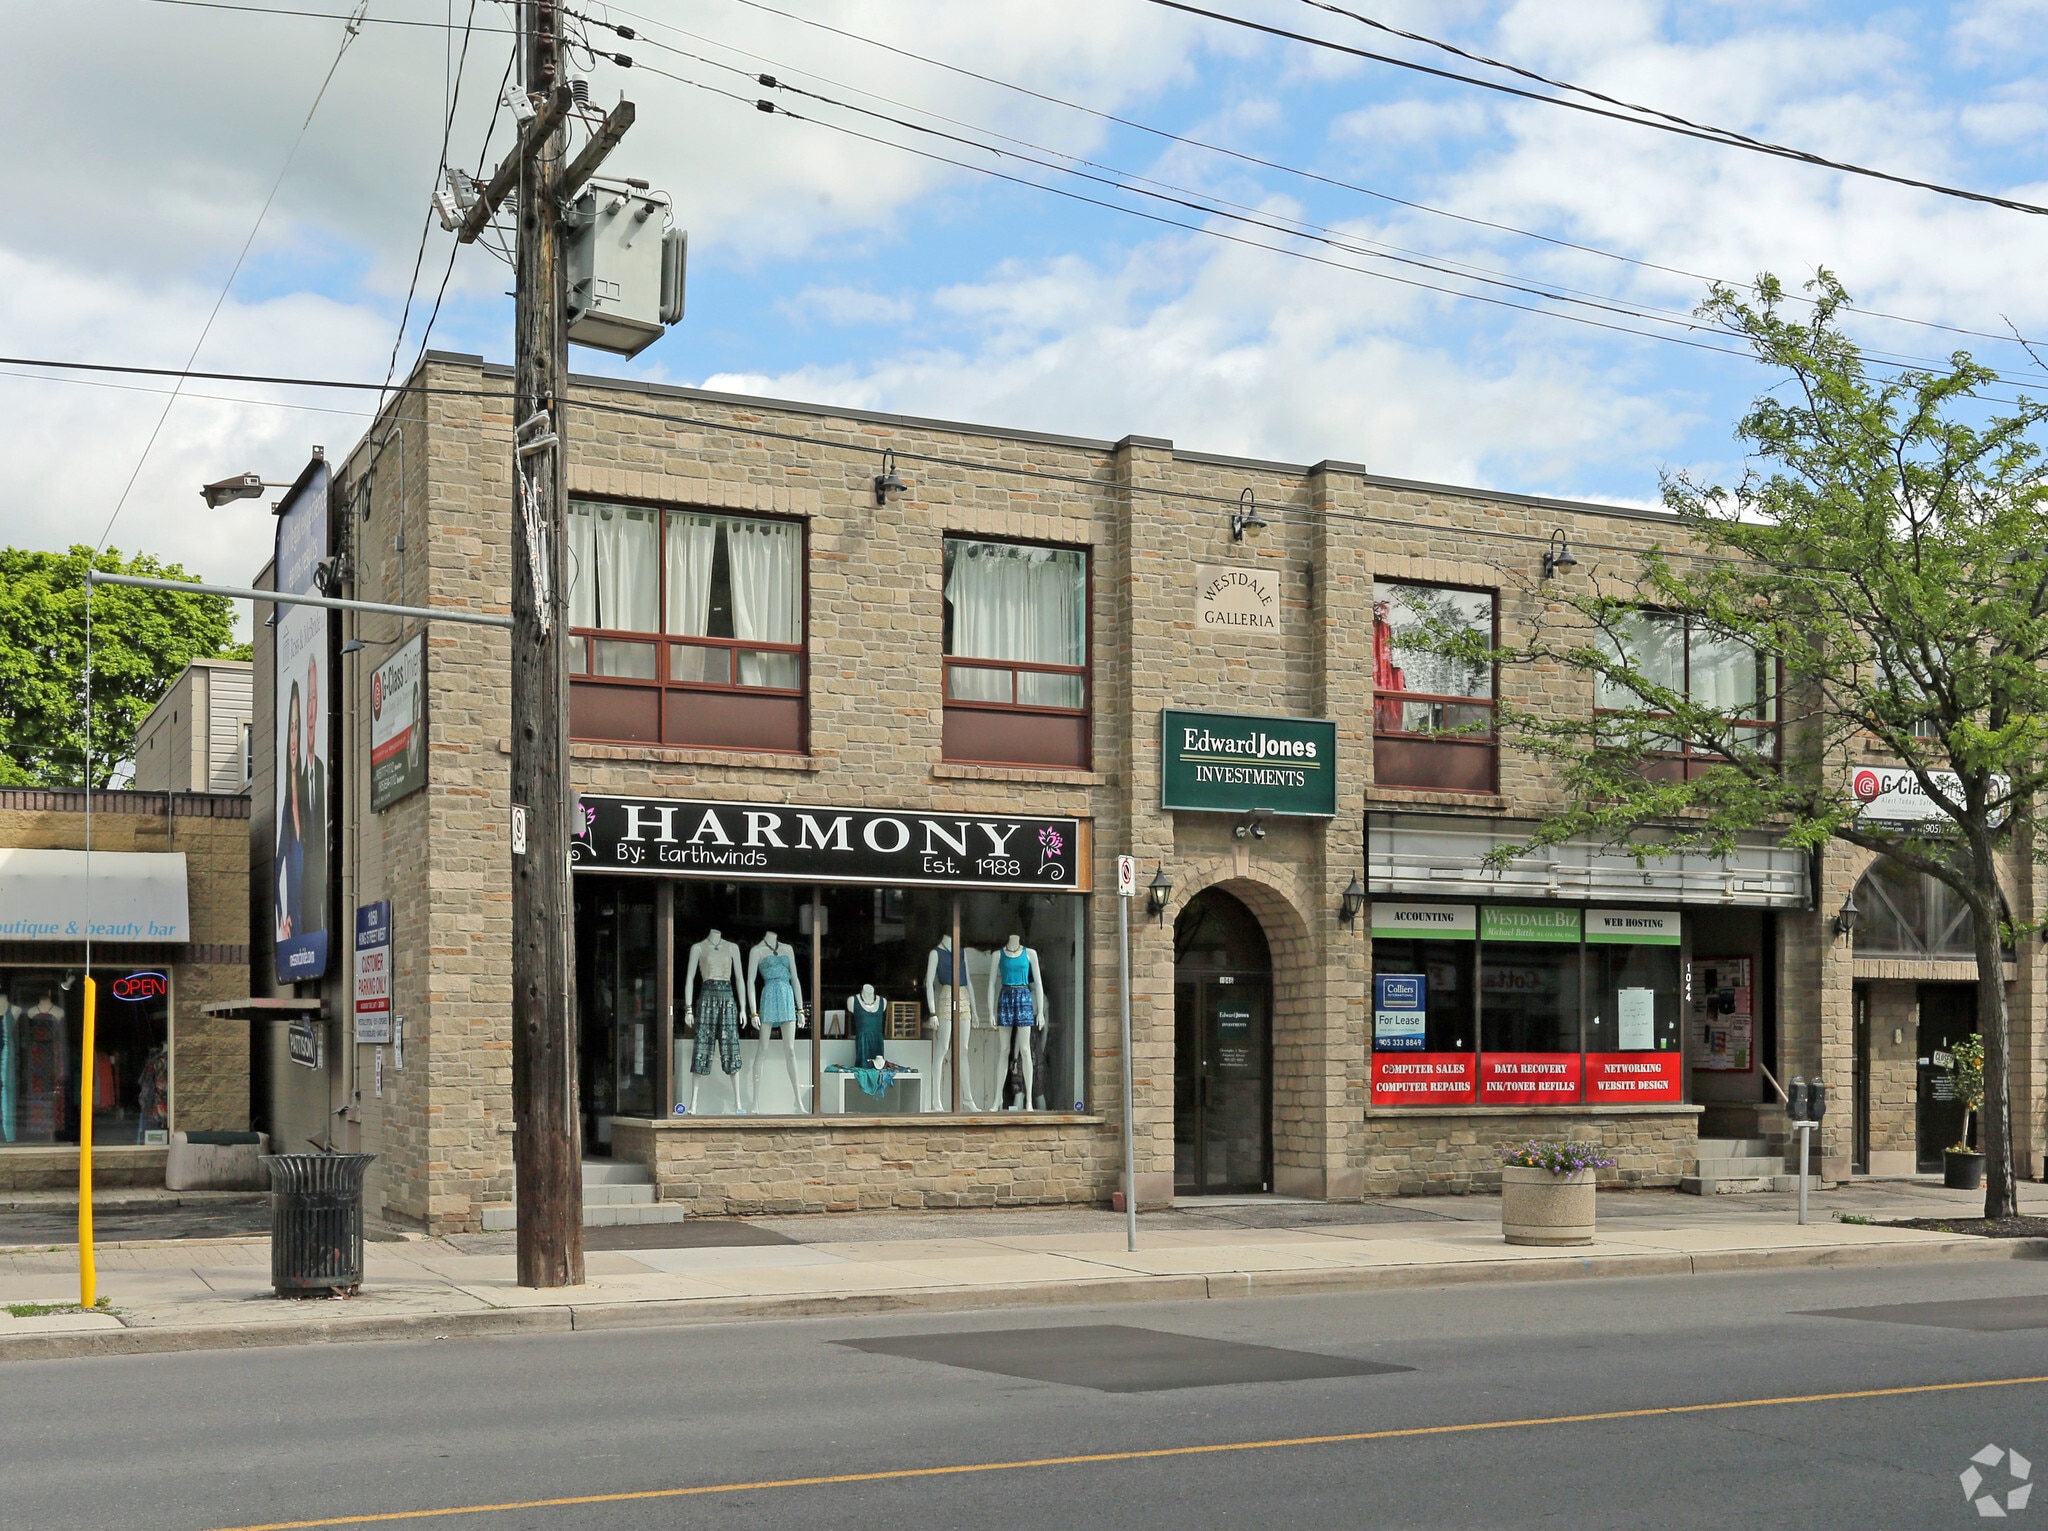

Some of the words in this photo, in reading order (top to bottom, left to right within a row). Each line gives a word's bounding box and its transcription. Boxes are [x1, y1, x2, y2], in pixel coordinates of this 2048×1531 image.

[1203, 572, 1273, 607] WESTDALE
[1204, 610, 1275, 628] GALLERIA
[382, 665, 403, 700] G-Class
[1195, 765, 1306, 787] INVESTMENTS
[1881, 774, 1925, 796] G-Cla
[621, 804, 1022, 858] HARMONY
[617, 842, 646, 864] By:
[659, 843, 768, 867] Earthwinds
[922, 855, 960, 876] Est.
[976, 857, 1021, 877] 1988
[1393, 910, 1454, 923] ACCOUNTING
[1604, 917, 1623, 928] WEB
[1625, 917, 1663, 929] HOSTING
[65, 921, 79, 935] &
[85, 920, 143, 939] beauty
[148, 920, 176, 936] bar
[1487, 927, 1514, 937] Michael
[1515, 928, 1535, 937] Bittle
[362, 953, 383, 973] CUSTOMER
[113, 978, 166, 996] OPEN
[1387, 984, 1414, 993] Colliers
[1379, 1015, 1392, 1025] For
[1396, 1015, 1420, 1025] Lease
[290, 1033, 314, 1059] PATTISON
[1382, 1064, 1433, 1075] COMPUTER
[1436, 1064, 1465, 1075] SALES
[1494, 1064, 1519, 1075] DATA
[1521, 1064, 1567, 1075] RECOVERY
[1604, 1063, 1662, 1074] NETWORKING
[1376, 1082, 1428, 1093] COMPUTER
[1430, 1082, 1470, 1092] REPAIRS
[1486, 1081, 1536, 1092] INK/TONER
[1538, 1081, 1575, 1092] REFILLS
[1597, 1080, 1636, 1091] WEBSITE
[1637, 1080, 1669, 1090] DESIGN
